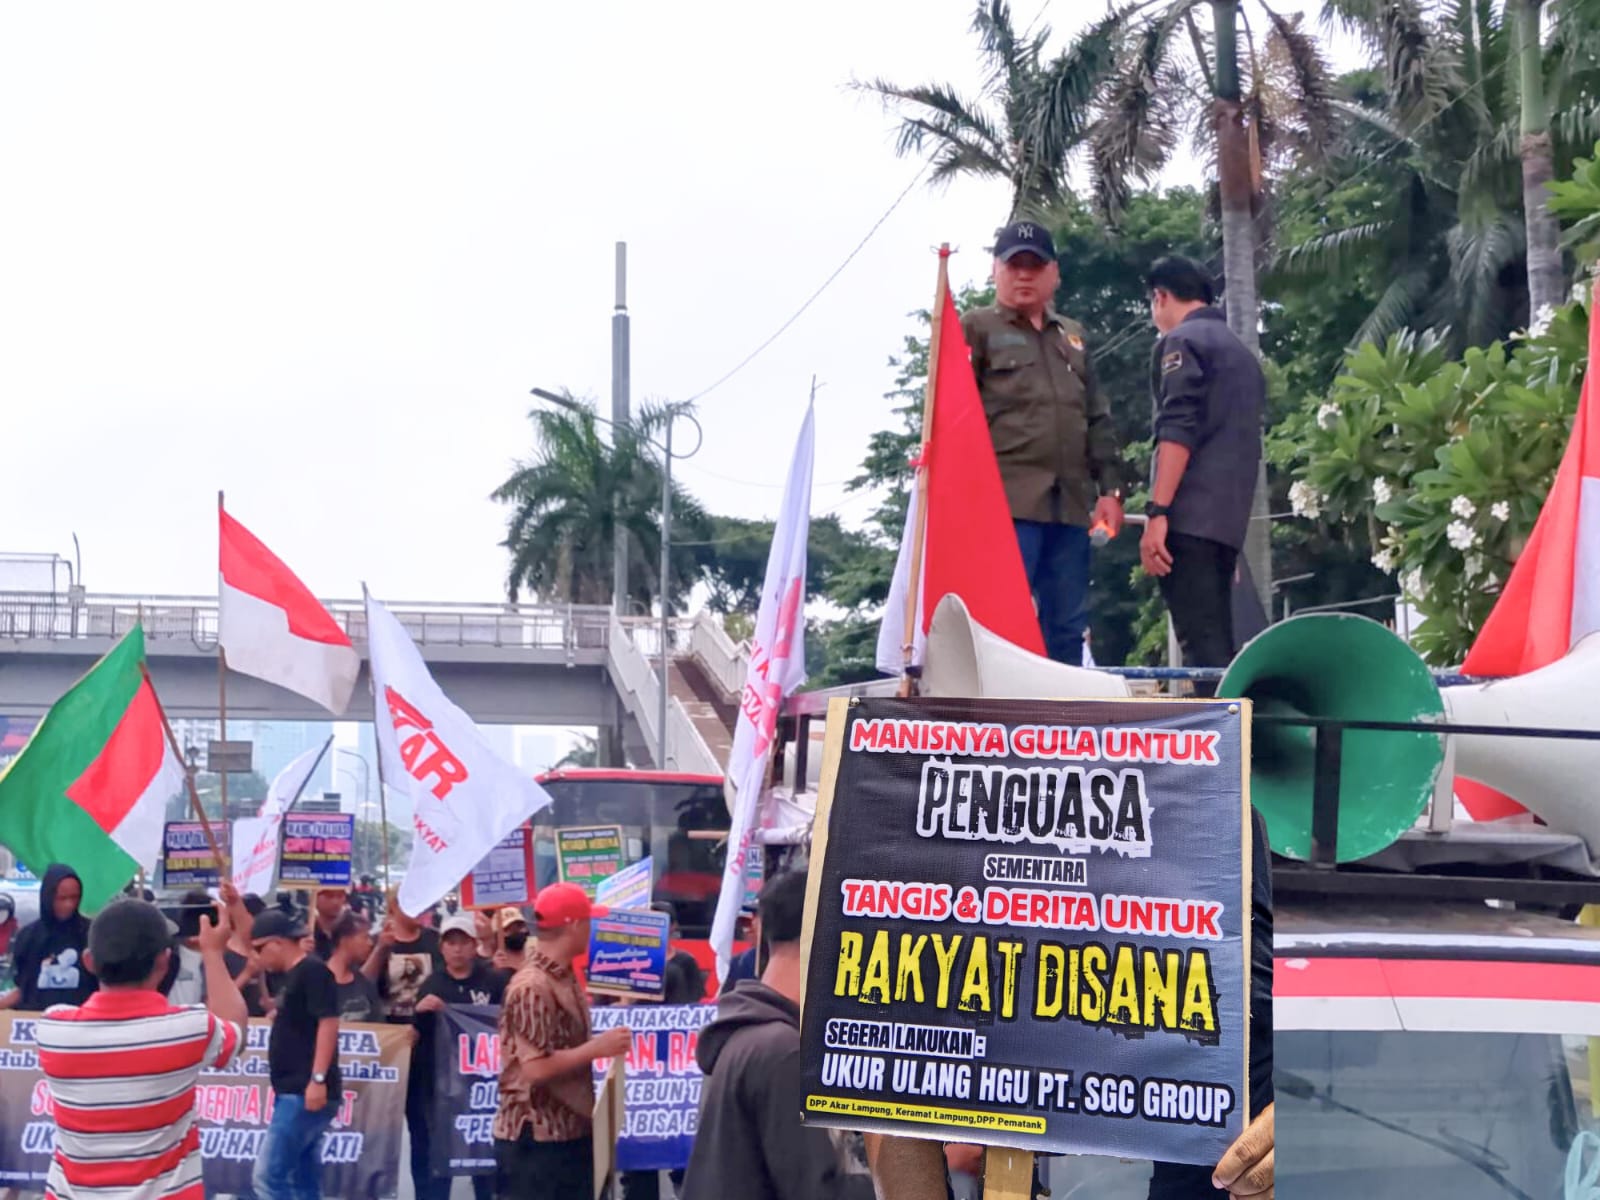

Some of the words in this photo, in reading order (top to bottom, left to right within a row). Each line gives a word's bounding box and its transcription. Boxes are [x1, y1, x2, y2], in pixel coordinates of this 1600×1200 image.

[852, 720, 1006, 754] MANISNYA
[1012, 725, 1097, 758] GULA
[1104, 730, 1219, 763] UNTUK
[917, 763, 1150, 846] PENGUASA
[985, 856, 1086, 884] SEMENTARA
[843, 882, 948, 916] TANGIS
[952, 887, 977, 919] &
[985, 891, 1096, 927] DERITA
[1104, 904, 1221, 936] UNTUK
[834, 930, 1023, 1018] RAKYAT
[1035, 944, 1216, 1032] DISANA
[677, 1007, 717, 1028] RAK
[826, 1020, 891, 1049] SEGERA
[821, 1053, 885, 1091] UKUR
[892, 1059, 971, 1099] ULANG
[979, 1066, 1029, 1105] HGU
[1038, 1072, 1075, 1109] PT.
[1084, 1077, 1135, 1114] SGC
[1143, 1081, 1230, 1123] GROUP
[809, 1098, 828, 1109] DPP
[829, 1101, 850, 1112] Akar
[852, 1103, 893, 1117] Lampung,
[895, 1107, 932, 1120] Keramat
[998, 1117, 1043, 1131] Pematank
